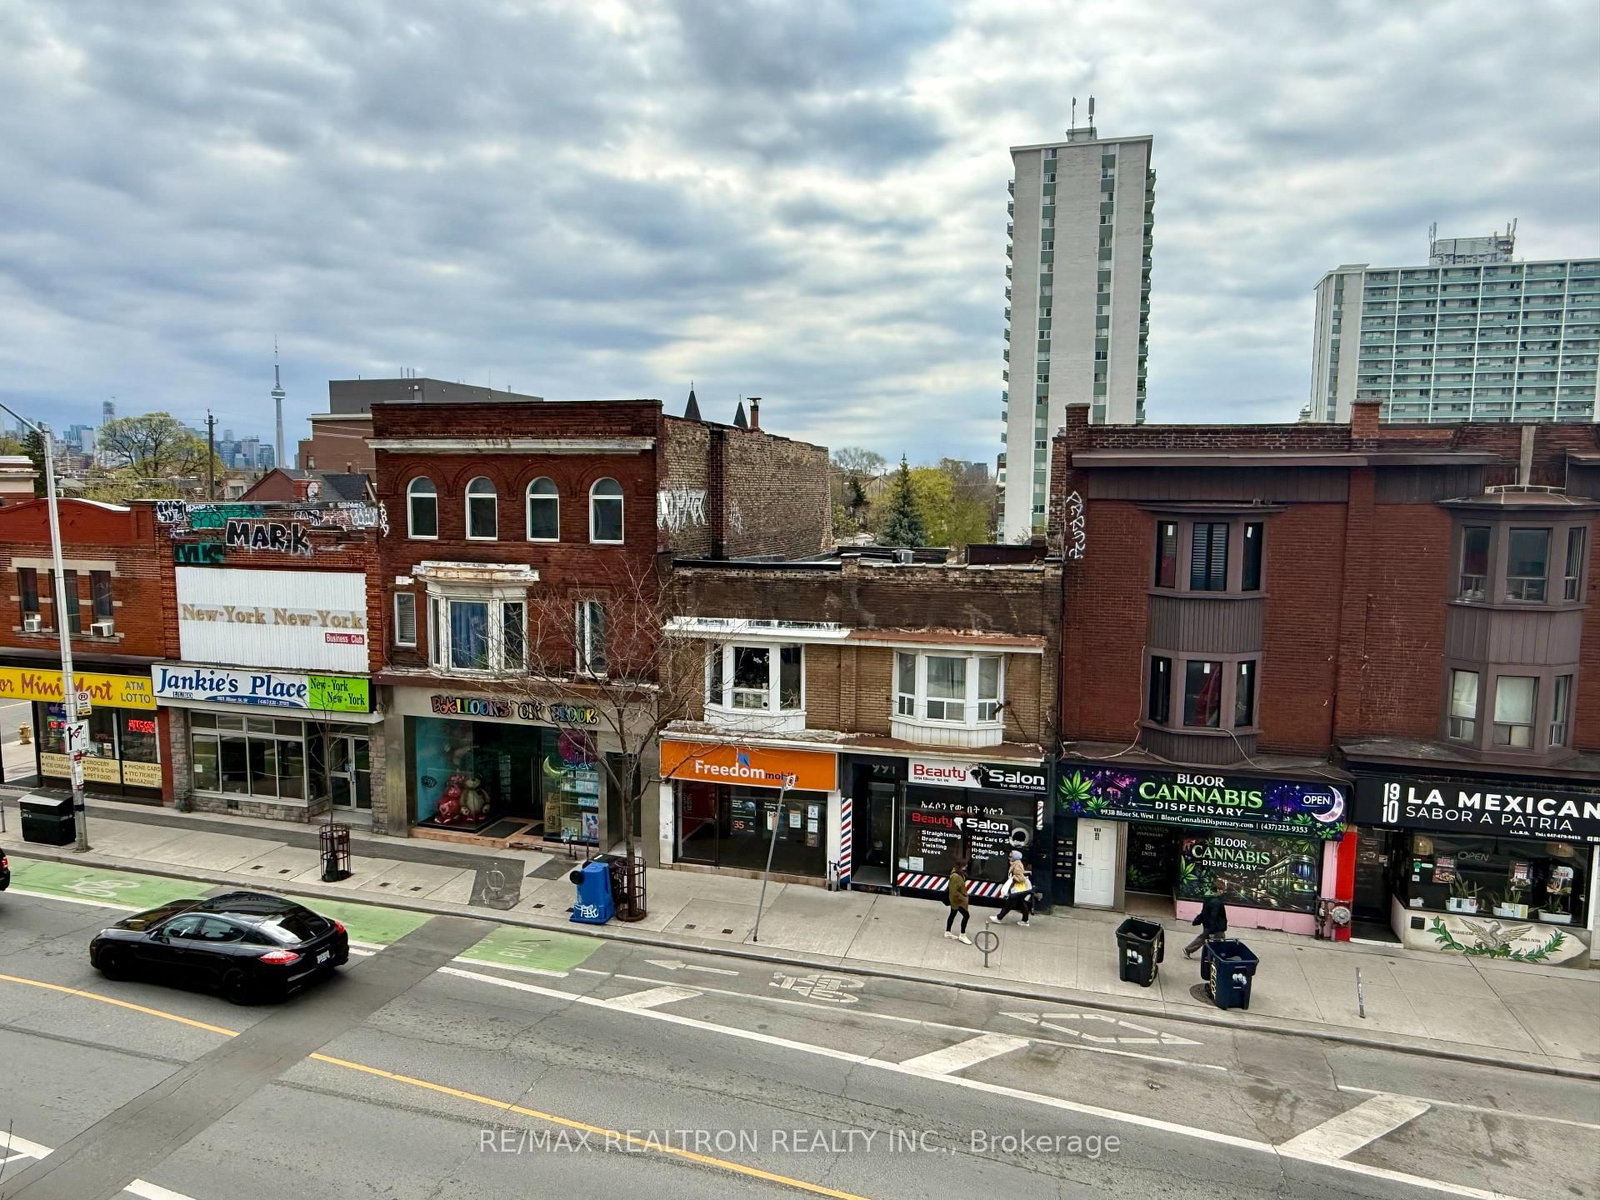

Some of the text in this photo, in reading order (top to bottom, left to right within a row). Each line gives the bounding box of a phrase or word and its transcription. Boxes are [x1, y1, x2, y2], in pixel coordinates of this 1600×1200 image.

[226, 520, 314, 556] MARK
[181, 603, 364, 629] New-York New-York
[326, 633, 364, 644] Business Club
[21, 672, 63, 697] Mini
[124, 680, 146, 691] ATM
[157, 668, 308, 698] Jankie's Place
[310, 677, 326, 690] New
[331, 679, 349, 692] York
[120, 692, 151, 704] LOTTO
[327, 691, 343, 704] New
[348, 692, 366, 706] York
[430, 694, 513, 719] BALLOONS
[695, 760, 766, 779] Freedom
[913, 763, 967, 782] Beauty
[988, 769, 1045, 786] Salon
[1176, 773, 1225, 788] BLOOR
[1138, 781, 1264, 809] CANNABIS
[1302, 794, 1331, 806] OPEN
[1407, 787, 1600, 820] LA MEXICAN
[1154, 801, 1245, 817] DISPENSARY
[911, 812, 1009, 832] Beauty Salon
[1116, 809, 1132, 817] Bloor
[1140, 812, 1155, 820] West
[1160, 814, 1254, 829] BloorCannabisDispensary.com
[1405, 806, 1574, 832] SABOR A PATRIA
[1213, 836, 1248, 849] BLOOR
[1191, 844, 1272, 866] CANNABIS
[1457, 850, 1490, 862] OPEN
[1201, 858, 1258, 872] DISPENSARY
